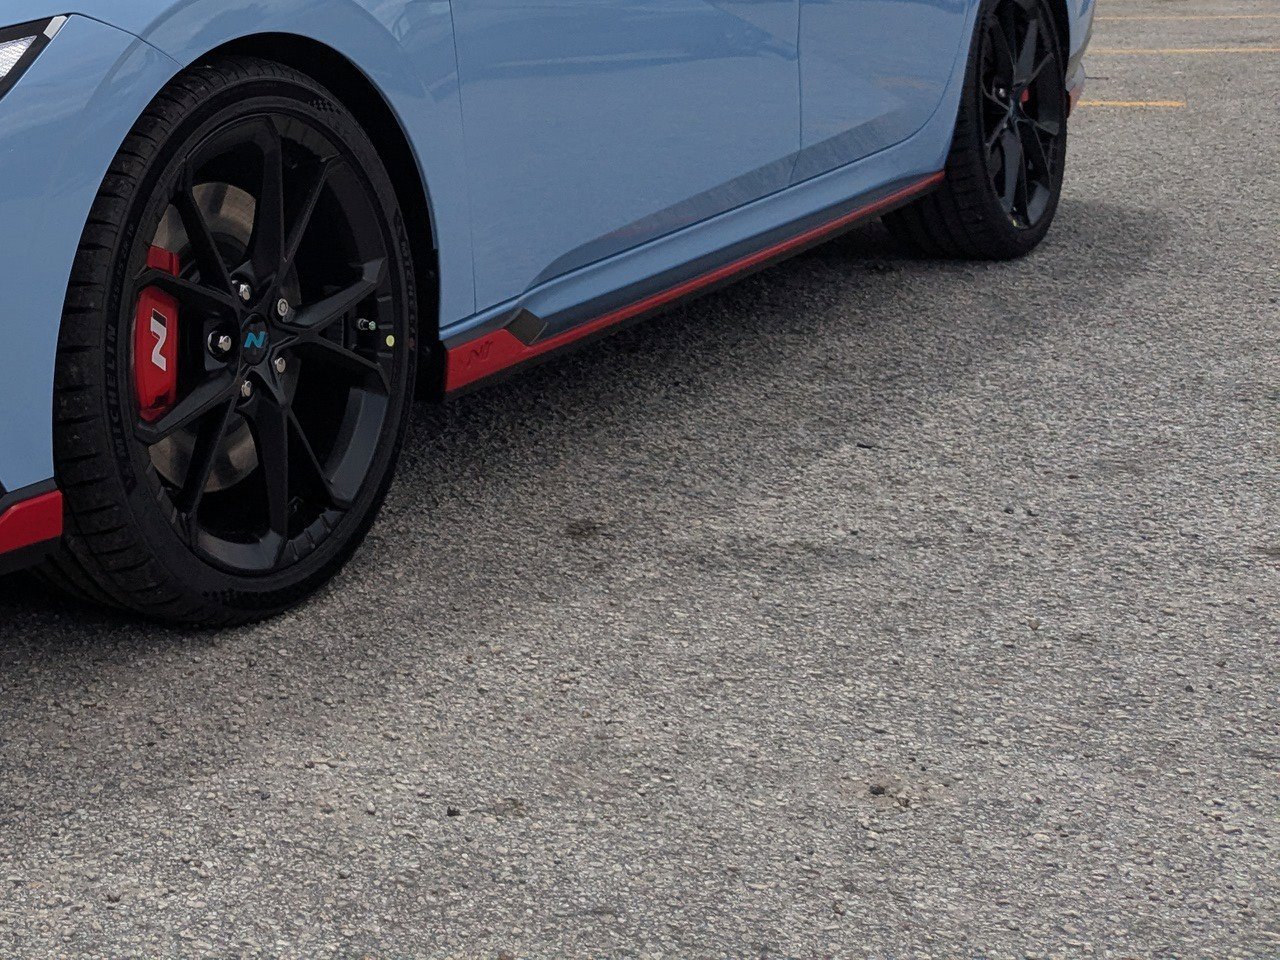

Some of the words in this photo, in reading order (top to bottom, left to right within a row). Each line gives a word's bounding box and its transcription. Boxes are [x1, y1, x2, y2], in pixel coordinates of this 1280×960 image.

[150, 308, 168, 372] N
[243, 330, 266, 349] N
[106, 324, 127, 458] MICHELIN
